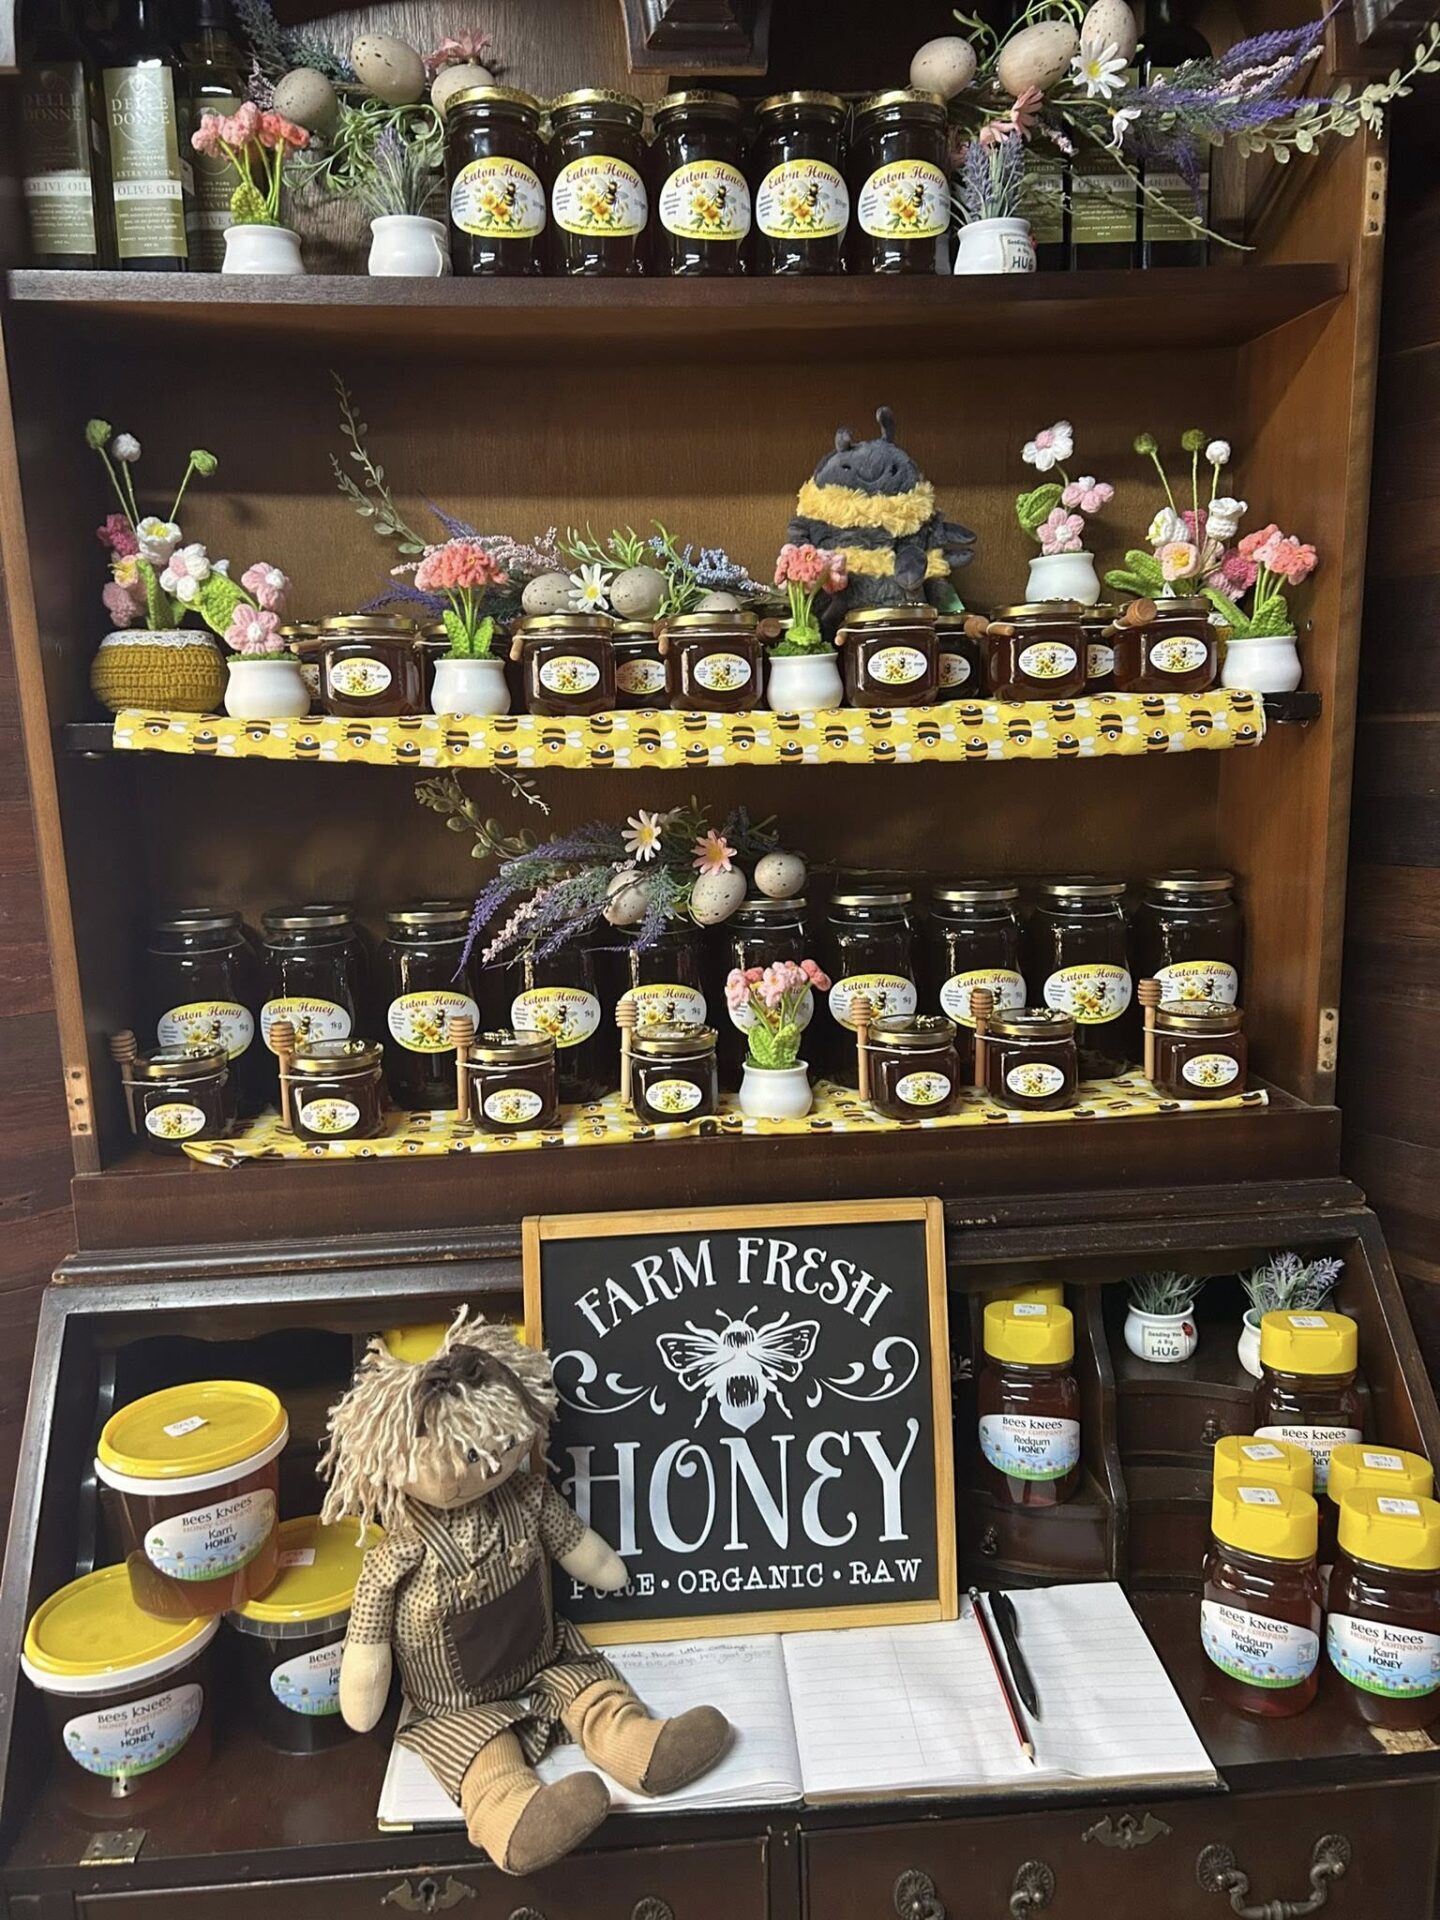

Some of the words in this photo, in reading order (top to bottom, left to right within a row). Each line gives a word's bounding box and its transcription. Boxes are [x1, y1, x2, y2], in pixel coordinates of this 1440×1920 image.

[464, 168, 496, 185] Eaton
[501, 164, 538, 189] Honey
[566, 167, 598, 183] Eaton
[604, 162, 640, 189] Honey
[675, 171, 708, 188] Eaton
[713, 167, 746, 192] Honey
[804, 165, 840, 189] Honey
[872, 171, 905, 190] Eaton
[910, 166, 944, 189] Honey
[118, 185, 154, 196] OLIVE
[157, 184, 180, 195] OIL
[1012, 255, 1033, 271] HUG
[1060, 972, 1090, 983] Eaton
[1094, 968, 1125, 982] Honey
[1168, 968, 1199, 979] Eaton
[1202, 965, 1232, 979] Honey
[842, 981, 870, 993] Eaton
[874, 977, 908, 991] Honey
[957, 977, 986, 988] Eaton
[990, 973, 1020, 987] Honey
[400, 999, 427, 1010] Eaton
[432, 995, 467, 1009] Honey
[523, 994, 550, 1006] Eaton
[554, 991, 588, 1006] Honey
[662, 988, 696, 1002] Honey
[171, 1011, 202, 1023] Eaton
[207, 1005, 242, 1019] Honey
[268, 1005, 292, 1015] Eaton
[297, 1002, 335, 1016] Honey
[330, 1021, 342, 1030] 1kg
[574, 1238, 717, 1339] FARM
[737, 1236, 893, 1327] FRESH
[1151, 1346, 1180, 1357] HUG
[1013, 1434, 1050, 1447] Redgum
[1018, 1445, 1046, 1454] HONEY
[1313, 1457, 1330, 1465] NEY
[561, 1416, 920, 1557] HONEY
[204, 1532, 238, 1551] HONEY
[677, 1562, 824, 1595] ORGANIC
[849, 1558, 923, 1585] RAW
[1231, 1629, 1273, 1650] Redgum
[1235, 1642, 1269, 1658] HONEY
[1368, 1655, 1403, 1670] HONEY
[120, 1730, 155, 1748] HONEY
